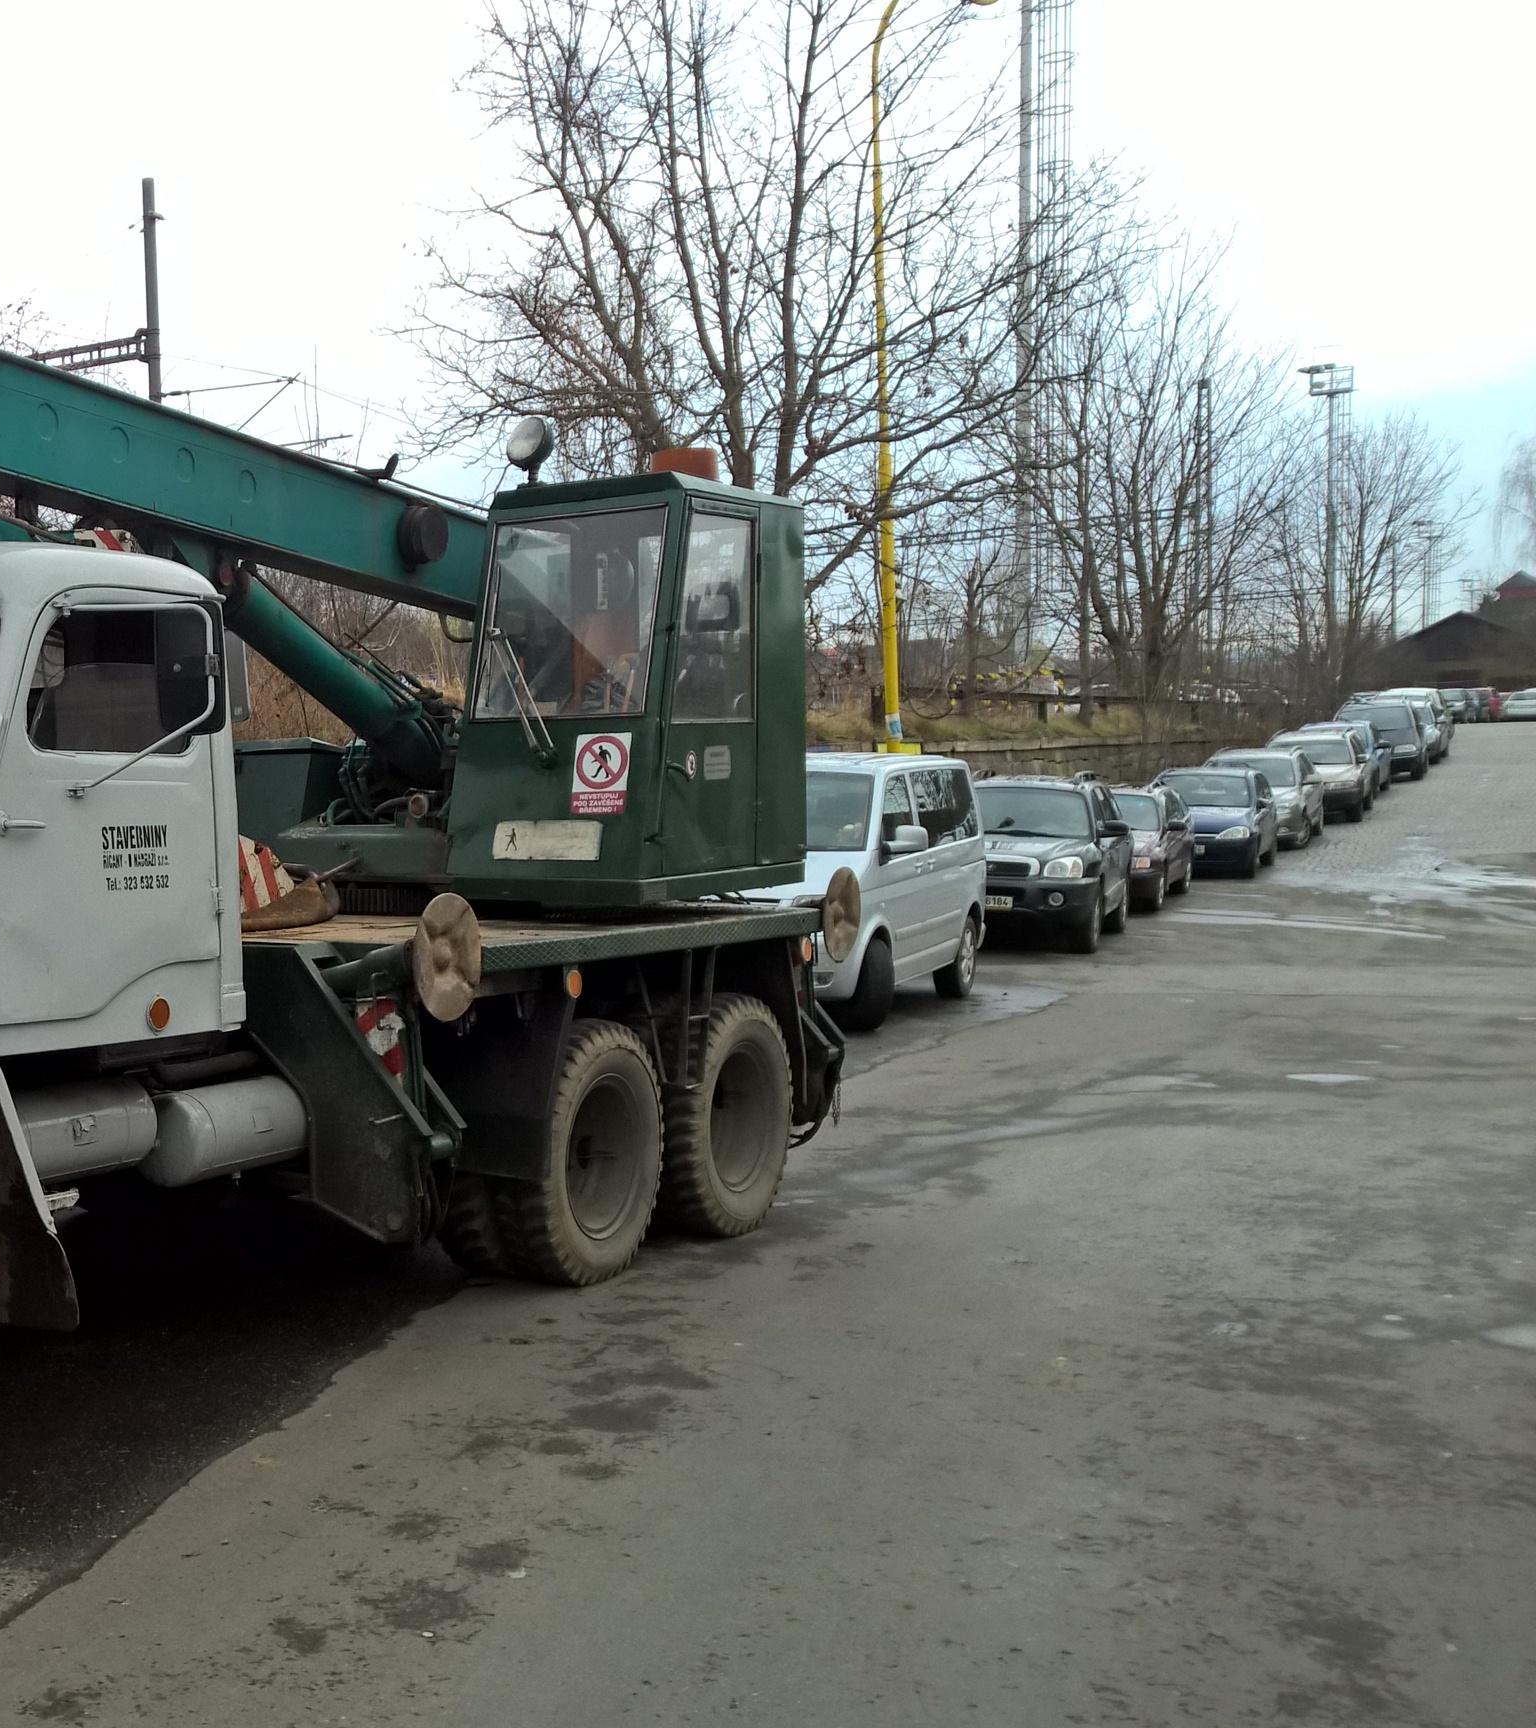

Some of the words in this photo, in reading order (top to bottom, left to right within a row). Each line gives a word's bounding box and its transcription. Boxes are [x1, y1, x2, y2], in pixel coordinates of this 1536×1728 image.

[101, 824, 167, 850] STAVEBNINY
[124, 876, 138, 890] 323
[140, 875, 154, 889] 632
[156, 874, 169, 889] 532
